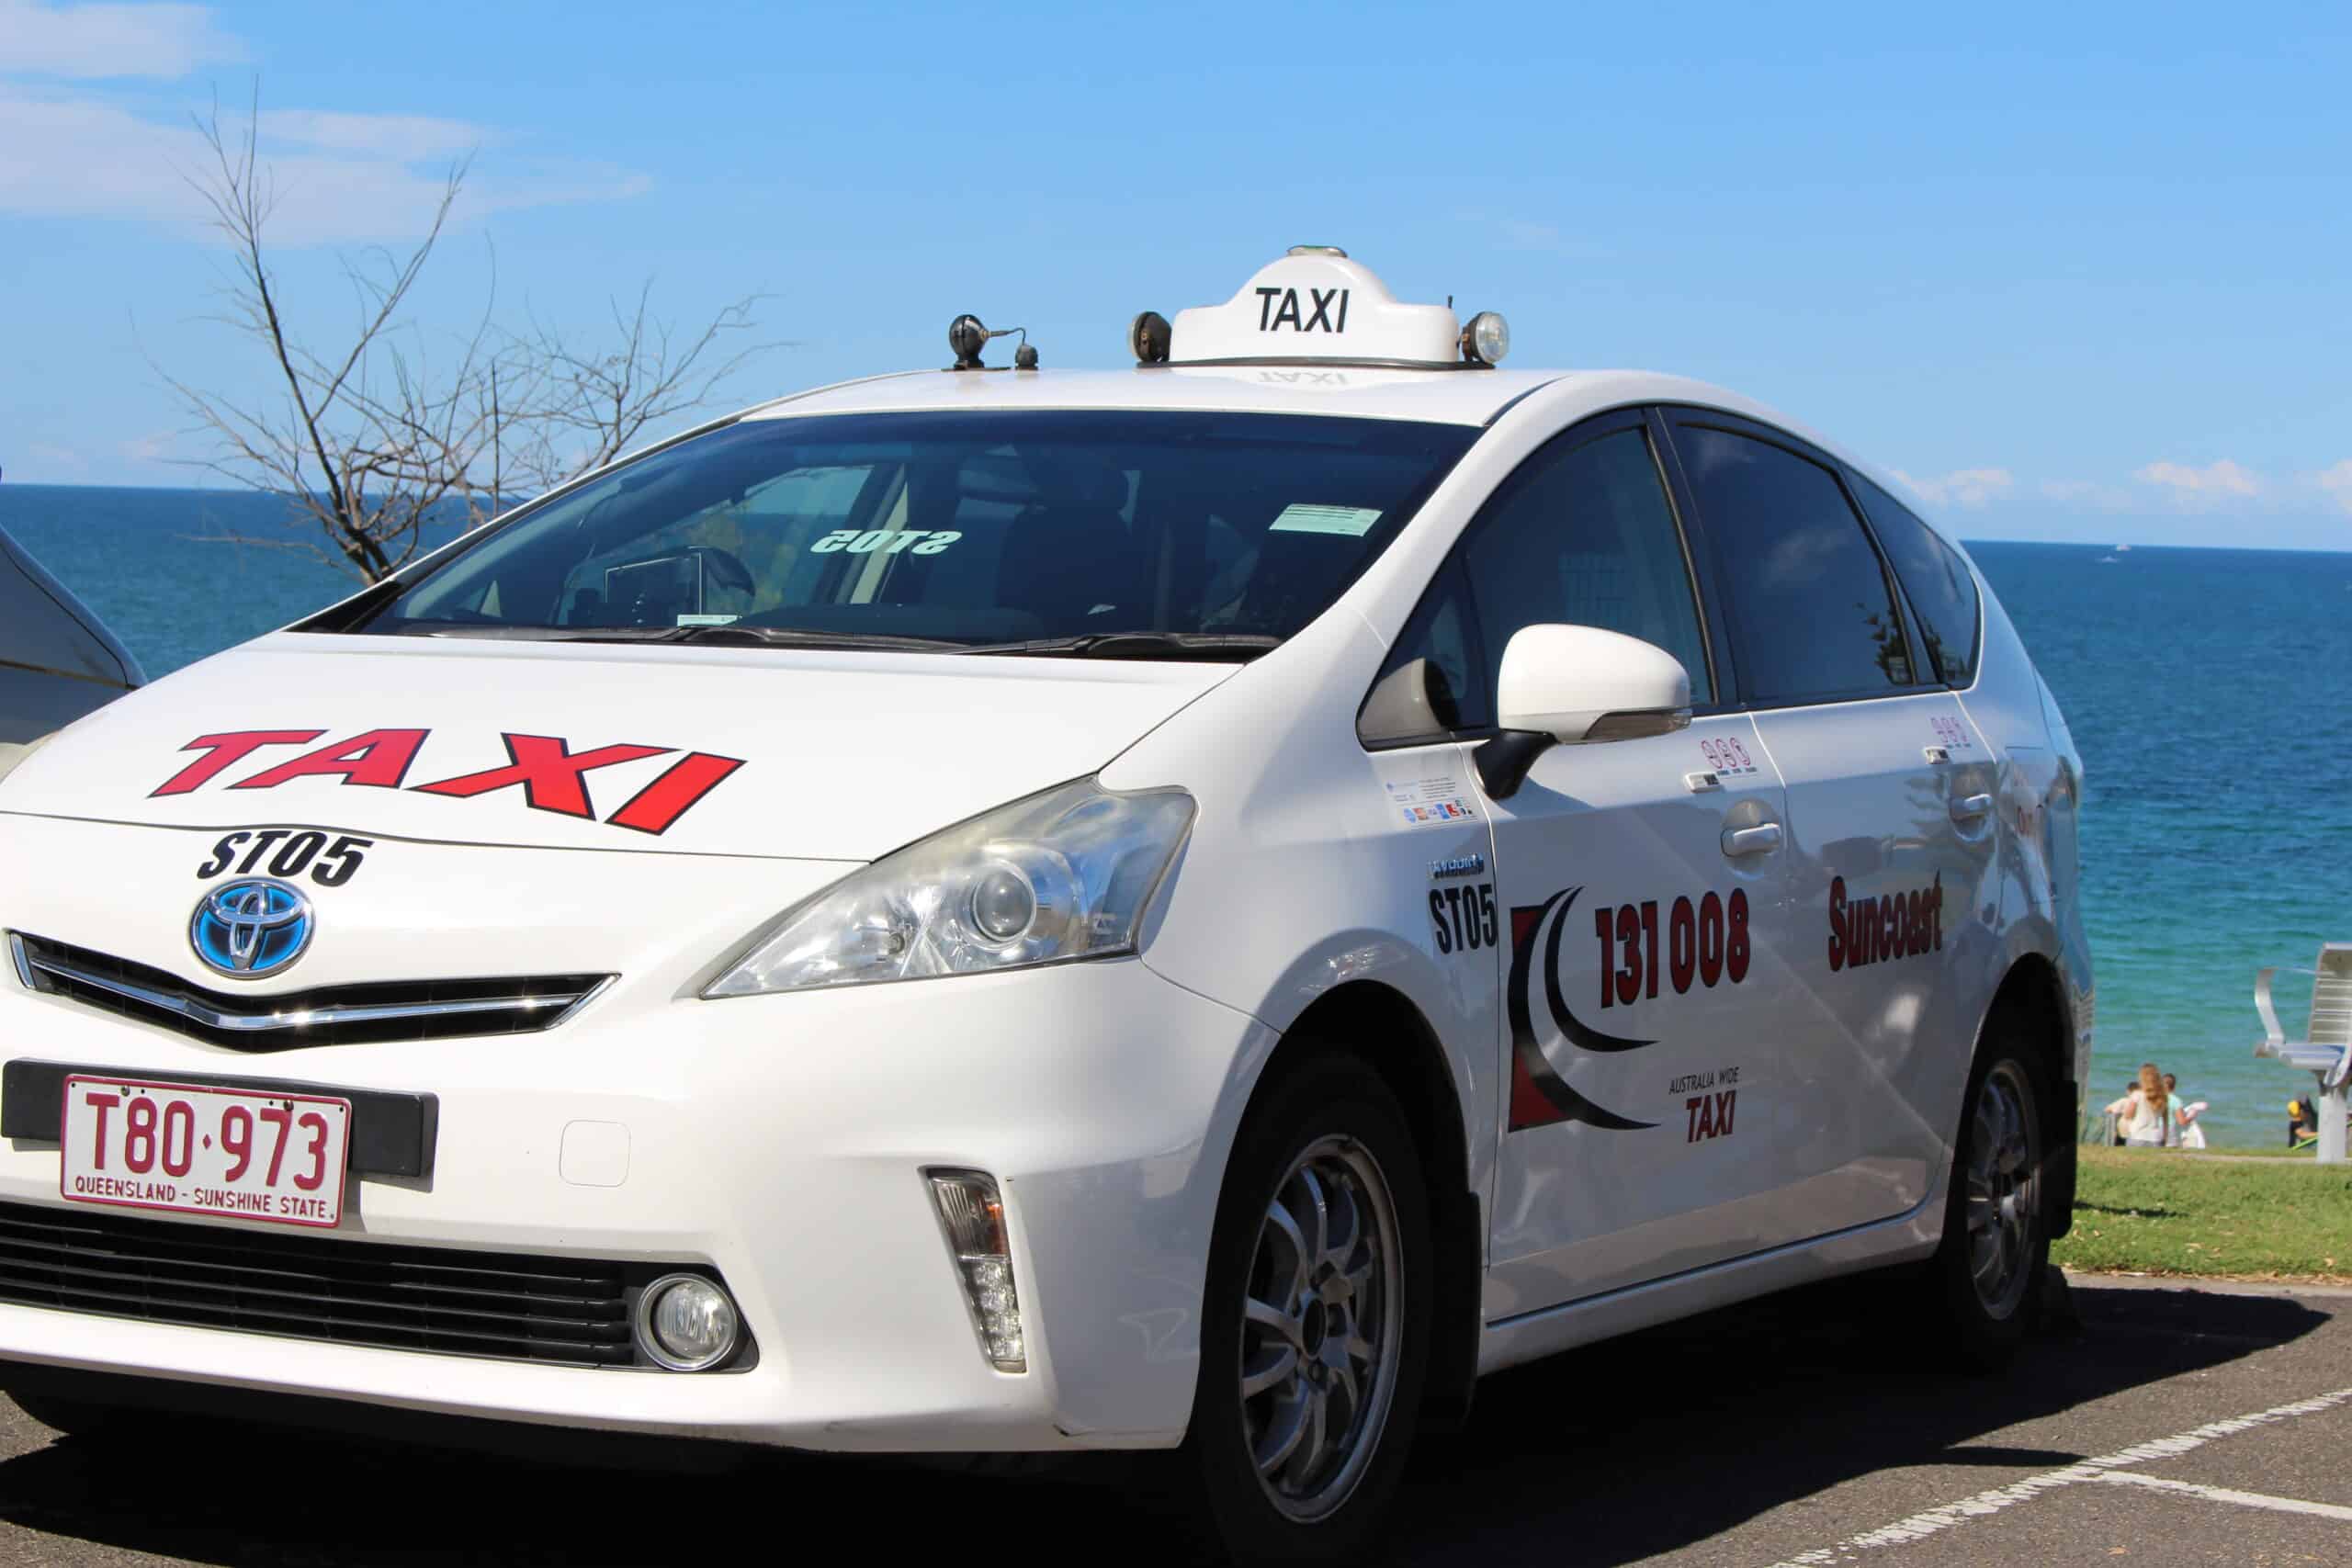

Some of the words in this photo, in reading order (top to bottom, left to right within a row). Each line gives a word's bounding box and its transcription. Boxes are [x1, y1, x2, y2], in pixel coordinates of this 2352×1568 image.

[1256, 288, 1349, 333] TAXI
[147, 728, 748, 836] TAXI
[1828, 868, 1943, 972] Suncoast
[1595, 899, 1658, 1009] 131
[1669, 887, 1750, 994] 008
[1668, 1072, 1714, 1095] AUSTRALIA
[1719, 1066, 1739, 1084] WIDE
[1686, 1089, 1736, 1143] TAXI
[75, 1175, 175, 1202] QUEENSLAND
[194, 1187, 271, 1213] SUNSHINE
[280, 1196, 326, 1219] STATE
